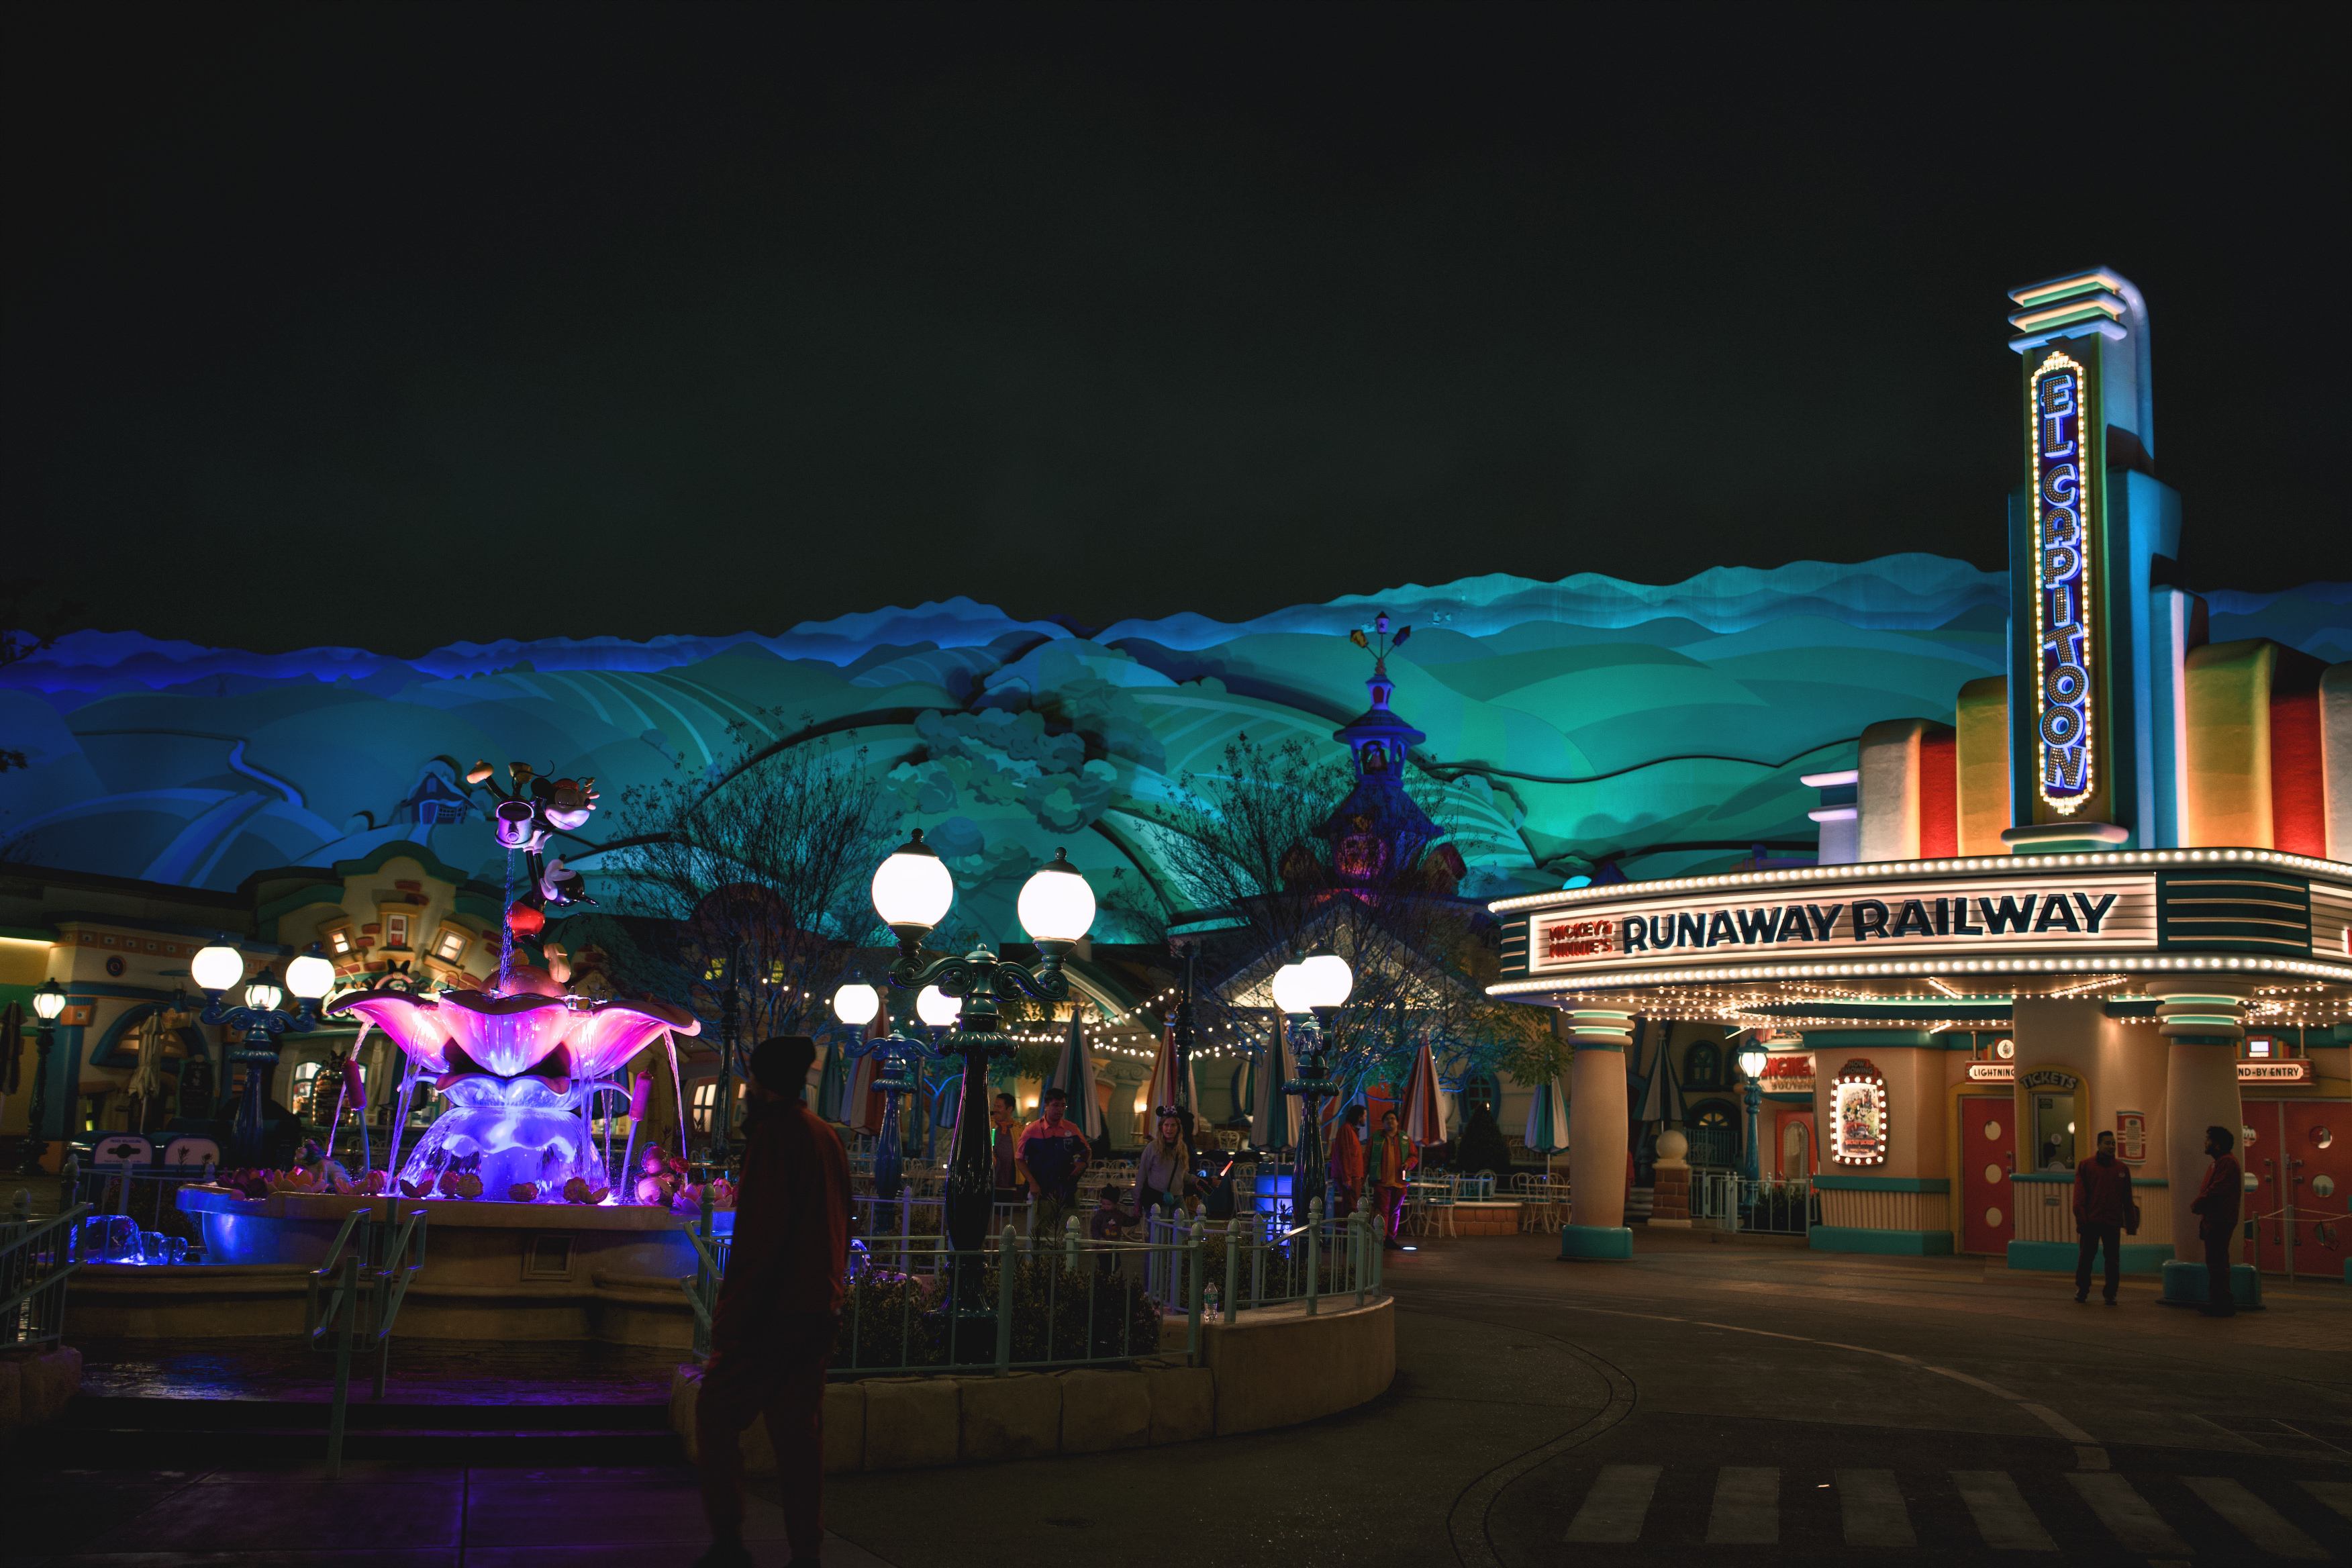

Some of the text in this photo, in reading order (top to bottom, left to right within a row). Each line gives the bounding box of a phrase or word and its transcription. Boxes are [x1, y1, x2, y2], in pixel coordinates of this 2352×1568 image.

[2039, 375, 2090, 789] EL CAPITOON
[1549, 920, 1604, 941] MICKEY
[1622, 892, 2118, 954] RUNAWAY RAILWAY
[1549, 938, 1612, 958] MINNIE'S
[1761, 1057, 1815, 1077] NGINE
[2270, 1068, 2299, 1076] ENTRY
[2018, 1071, 2078, 1089] TICKETS
